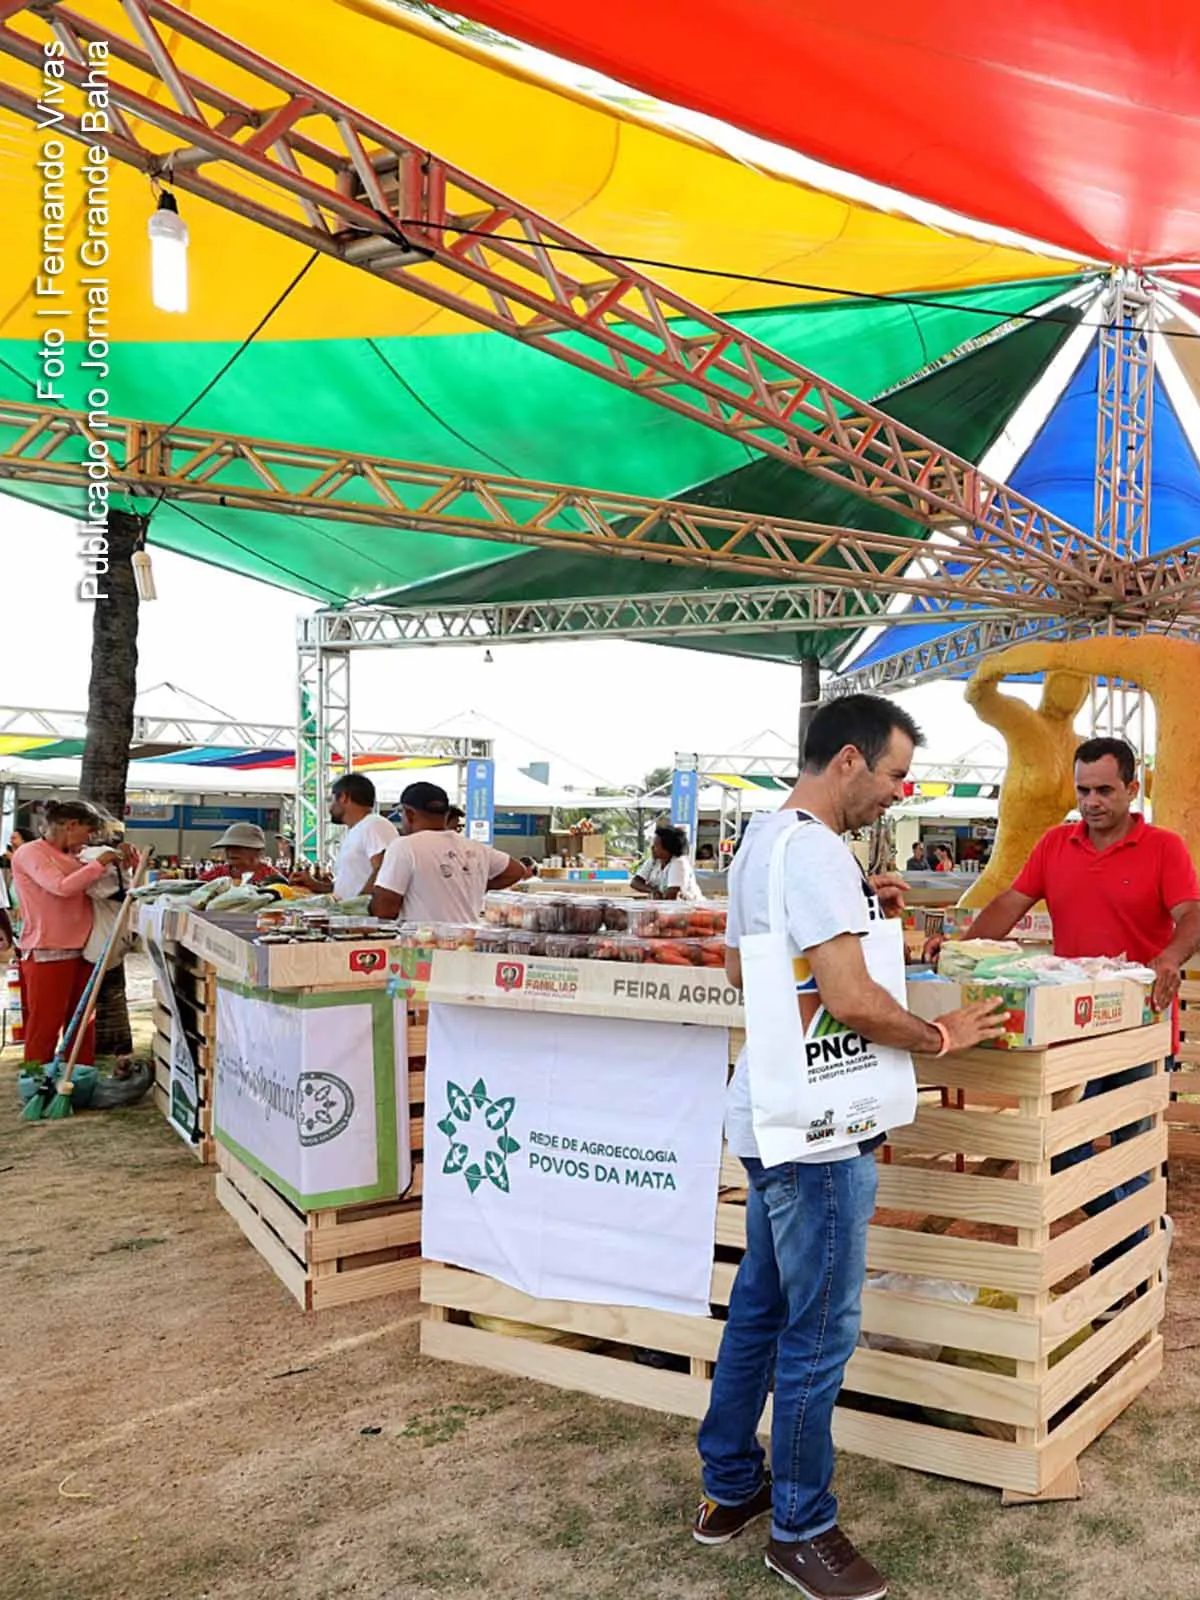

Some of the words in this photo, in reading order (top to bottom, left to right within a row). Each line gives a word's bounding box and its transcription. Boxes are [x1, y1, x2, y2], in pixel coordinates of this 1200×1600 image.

[525, 978, 578, 992] FAMILIAR
[613, 979, 671, 1001] FEIRA
[807, 1060, 844, 1076] PROGRAMA
[529, 1131, 559, 1147] REDE
[561, 1137, 578, 1151] DE
[580, 1141, 678, 1164] AGROECOLOGIA
[529, 1152, 590, 1180] POVOS
[594, 1164, 620, 1185] DA
[624, 1168, 677, 1191] MATA
